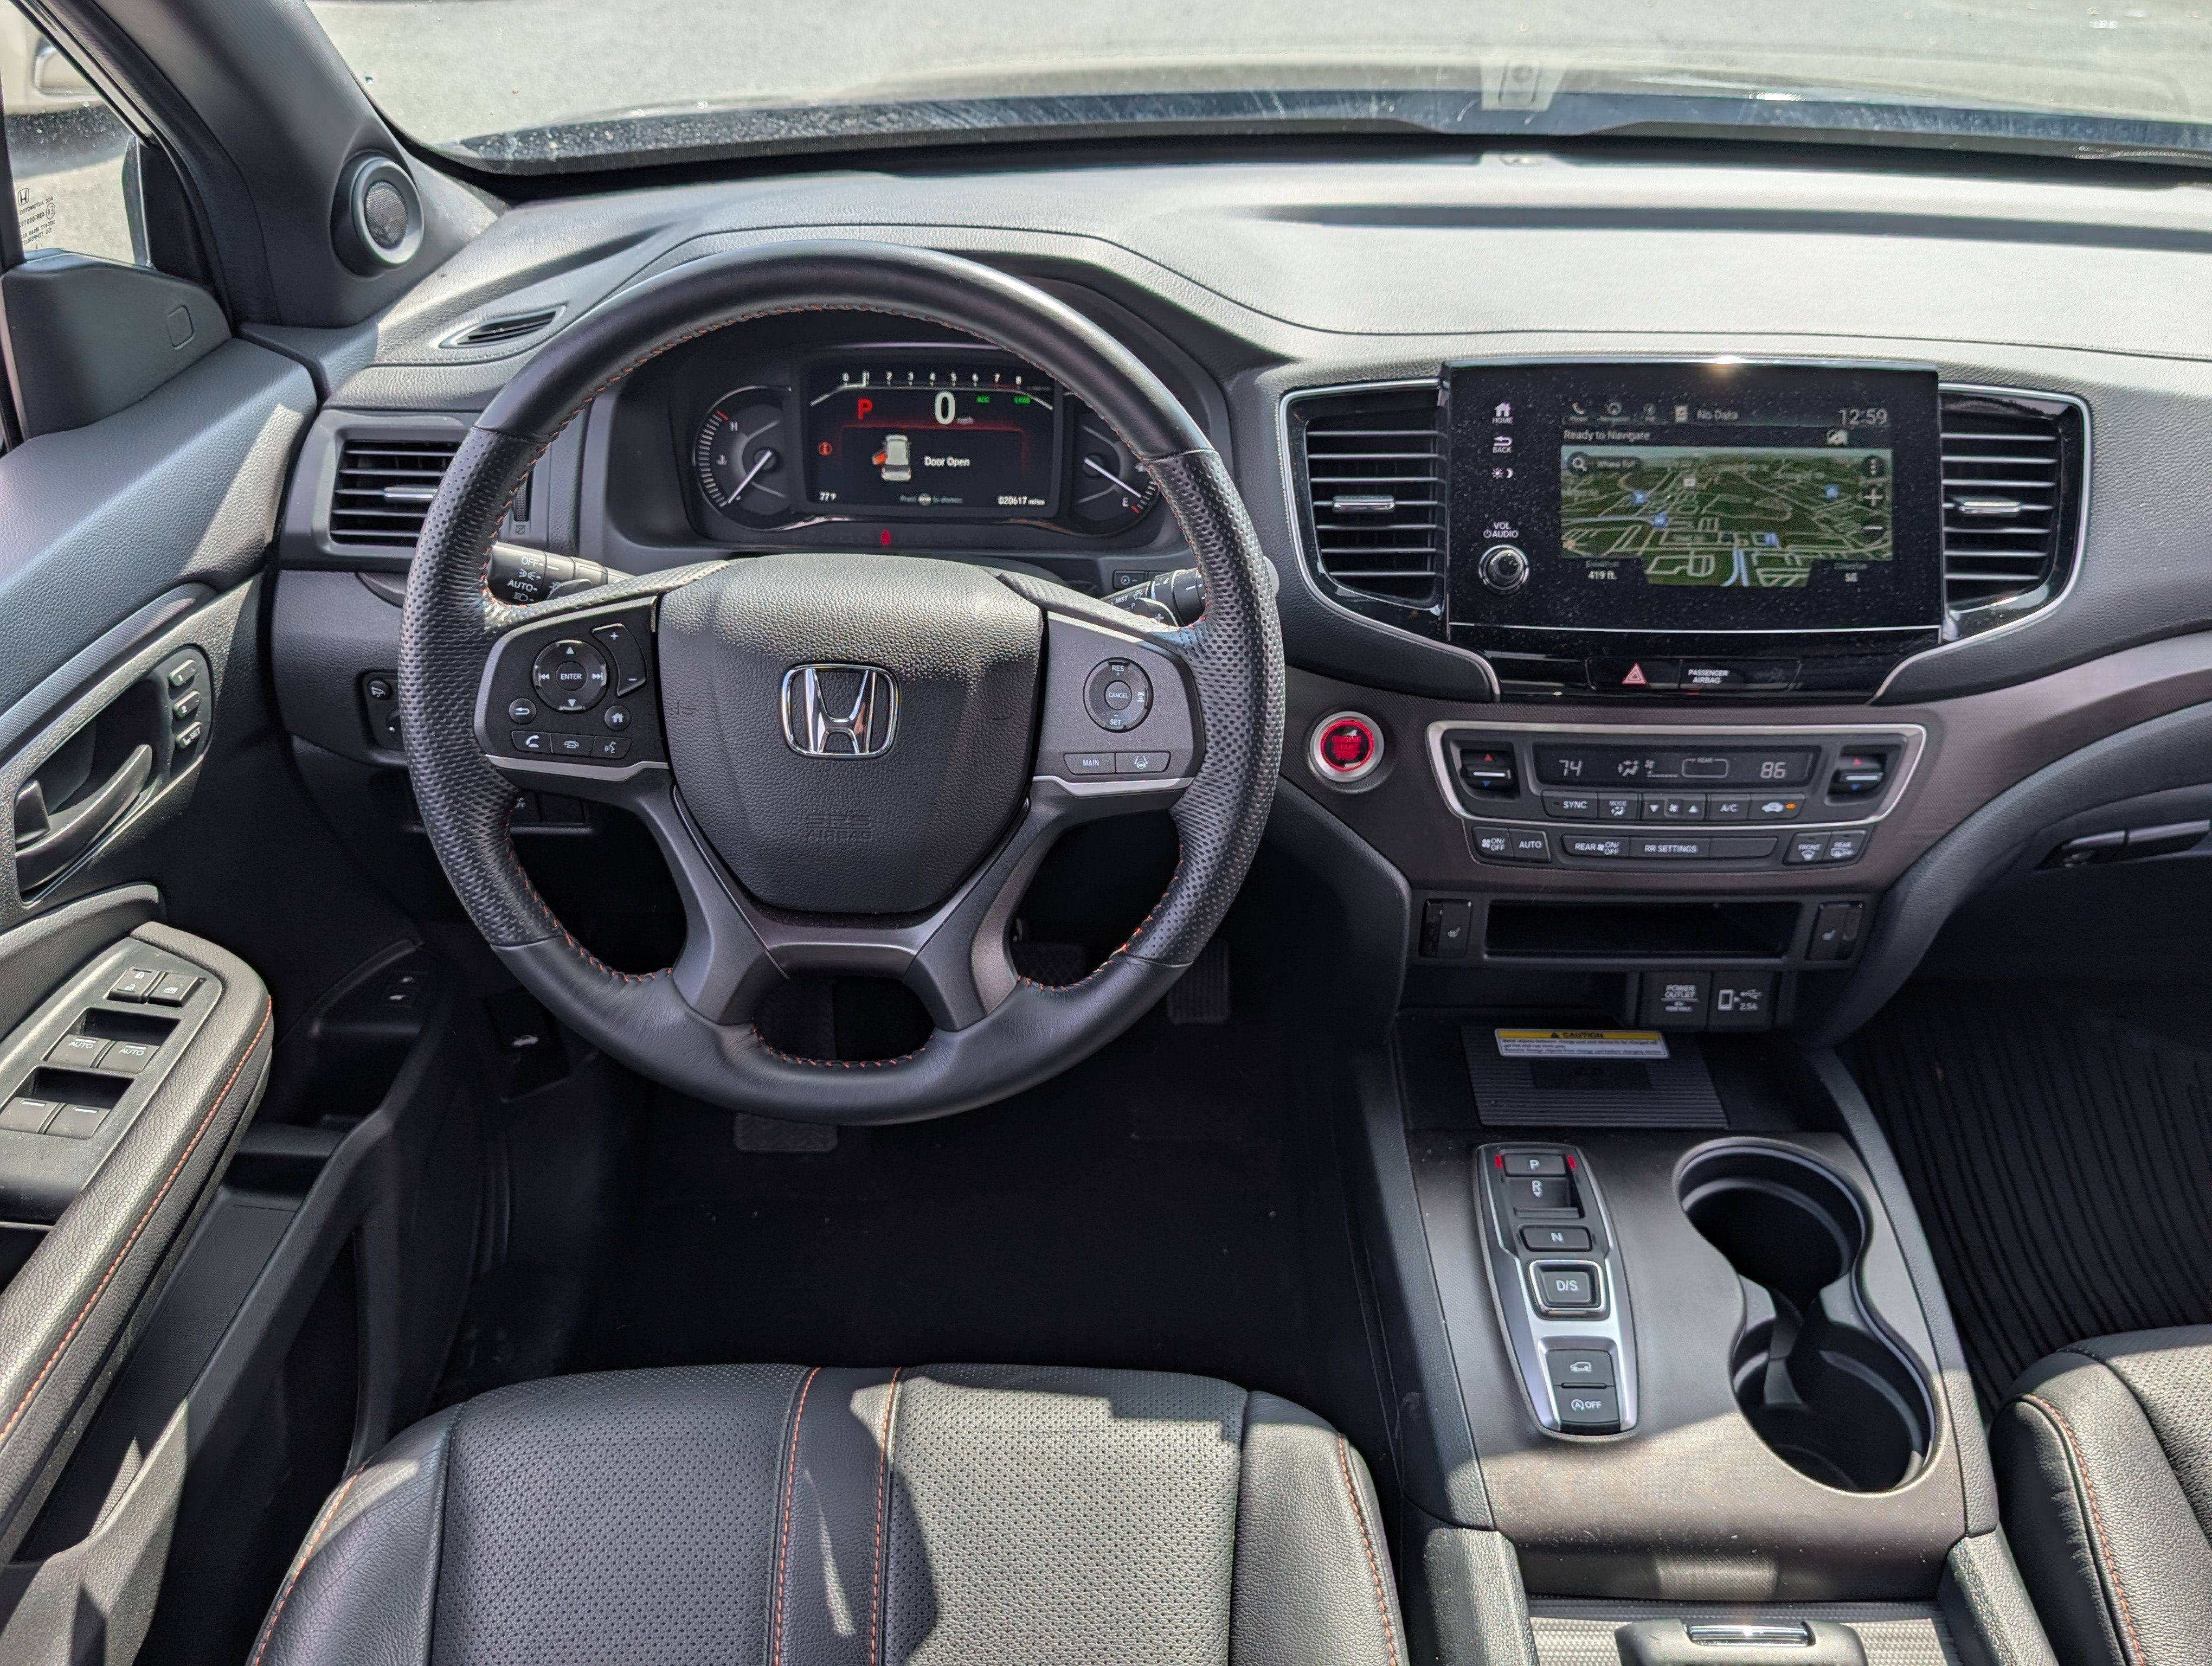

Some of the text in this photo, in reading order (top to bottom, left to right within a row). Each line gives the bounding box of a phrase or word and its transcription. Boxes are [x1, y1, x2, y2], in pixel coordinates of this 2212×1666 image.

[994, 373, 1000, 383] 7
[857, 398, 873, 420] P
[934, 390, 956, 425] 0
[1697, 410, 1739, 420] No Data
[1839, 408, 1888, 426] 12:59
[730, 421, 738, 431] H
[1564, 430, 1651, 443] Ready to Navigate
[924, 456, 970, 467] Door Open
[998, 495, 1027, 505] 020617
[1122, 497, 1129, 507] E
[1493, 521, 1511, 529] VOL
[1492, 530, 1519, 538] AUDIO
[521, 556, 539, 567] OFF
[1587, 571, 1605, 580] 419
[507, 579, 533, 592] AUTO
[1115, 595, 1128, 604] MIST
[1688, 668, 1730, 677] PASSENGER
[178, 674, 183, 682] 1
[1692, 676, 1722, 684] AIRBAG
[181, 705, 188, 714] 2
[190, 727, 201, 740] SET
[1559, 759, 1583, 777] 74
[1760, 761, 1786, 779] 86
[1562, 800, 1588, 809] SYNC
[1720, 803, 1738, 813] A/C
[1519, 841, 1542, 849] AUTO
[1575, 842, 1596, 851] REAR
[1644, 844, 1697, 853] RR SETTINGS
[68, 1041, 94, 1049] AUTO
[118, 1048, 145, 1056] AUTO
[1529, 1159, 1540, 1171] P
[1532, 1180, 1543, 1191] R
[1551, 1232, 1565, 1243] N
[1555, 1280, 1578, 1291] D/S
[1585, 1401, 1602, 1409] OFF
